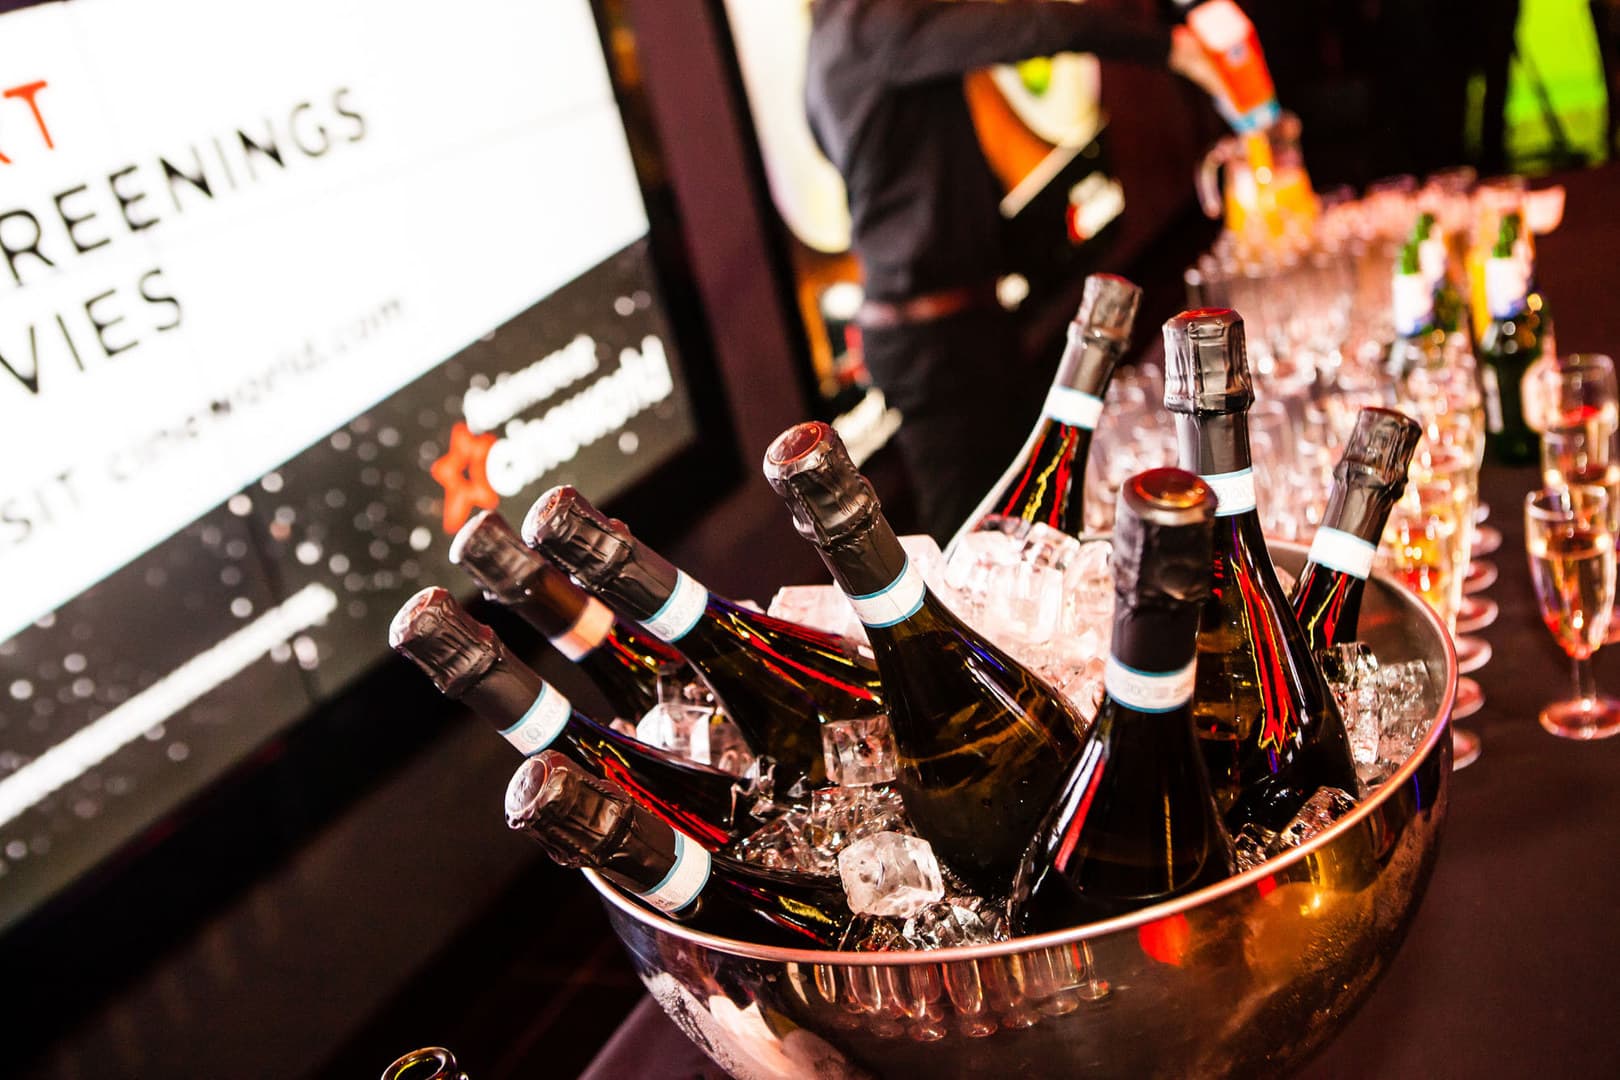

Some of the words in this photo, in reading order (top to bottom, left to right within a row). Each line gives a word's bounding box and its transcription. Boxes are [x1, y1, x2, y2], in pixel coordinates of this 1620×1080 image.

[0, 80, 54, 164] T
[0, 86, 368, 287] REENINGS
[0, 267, 183, 396] VIES
